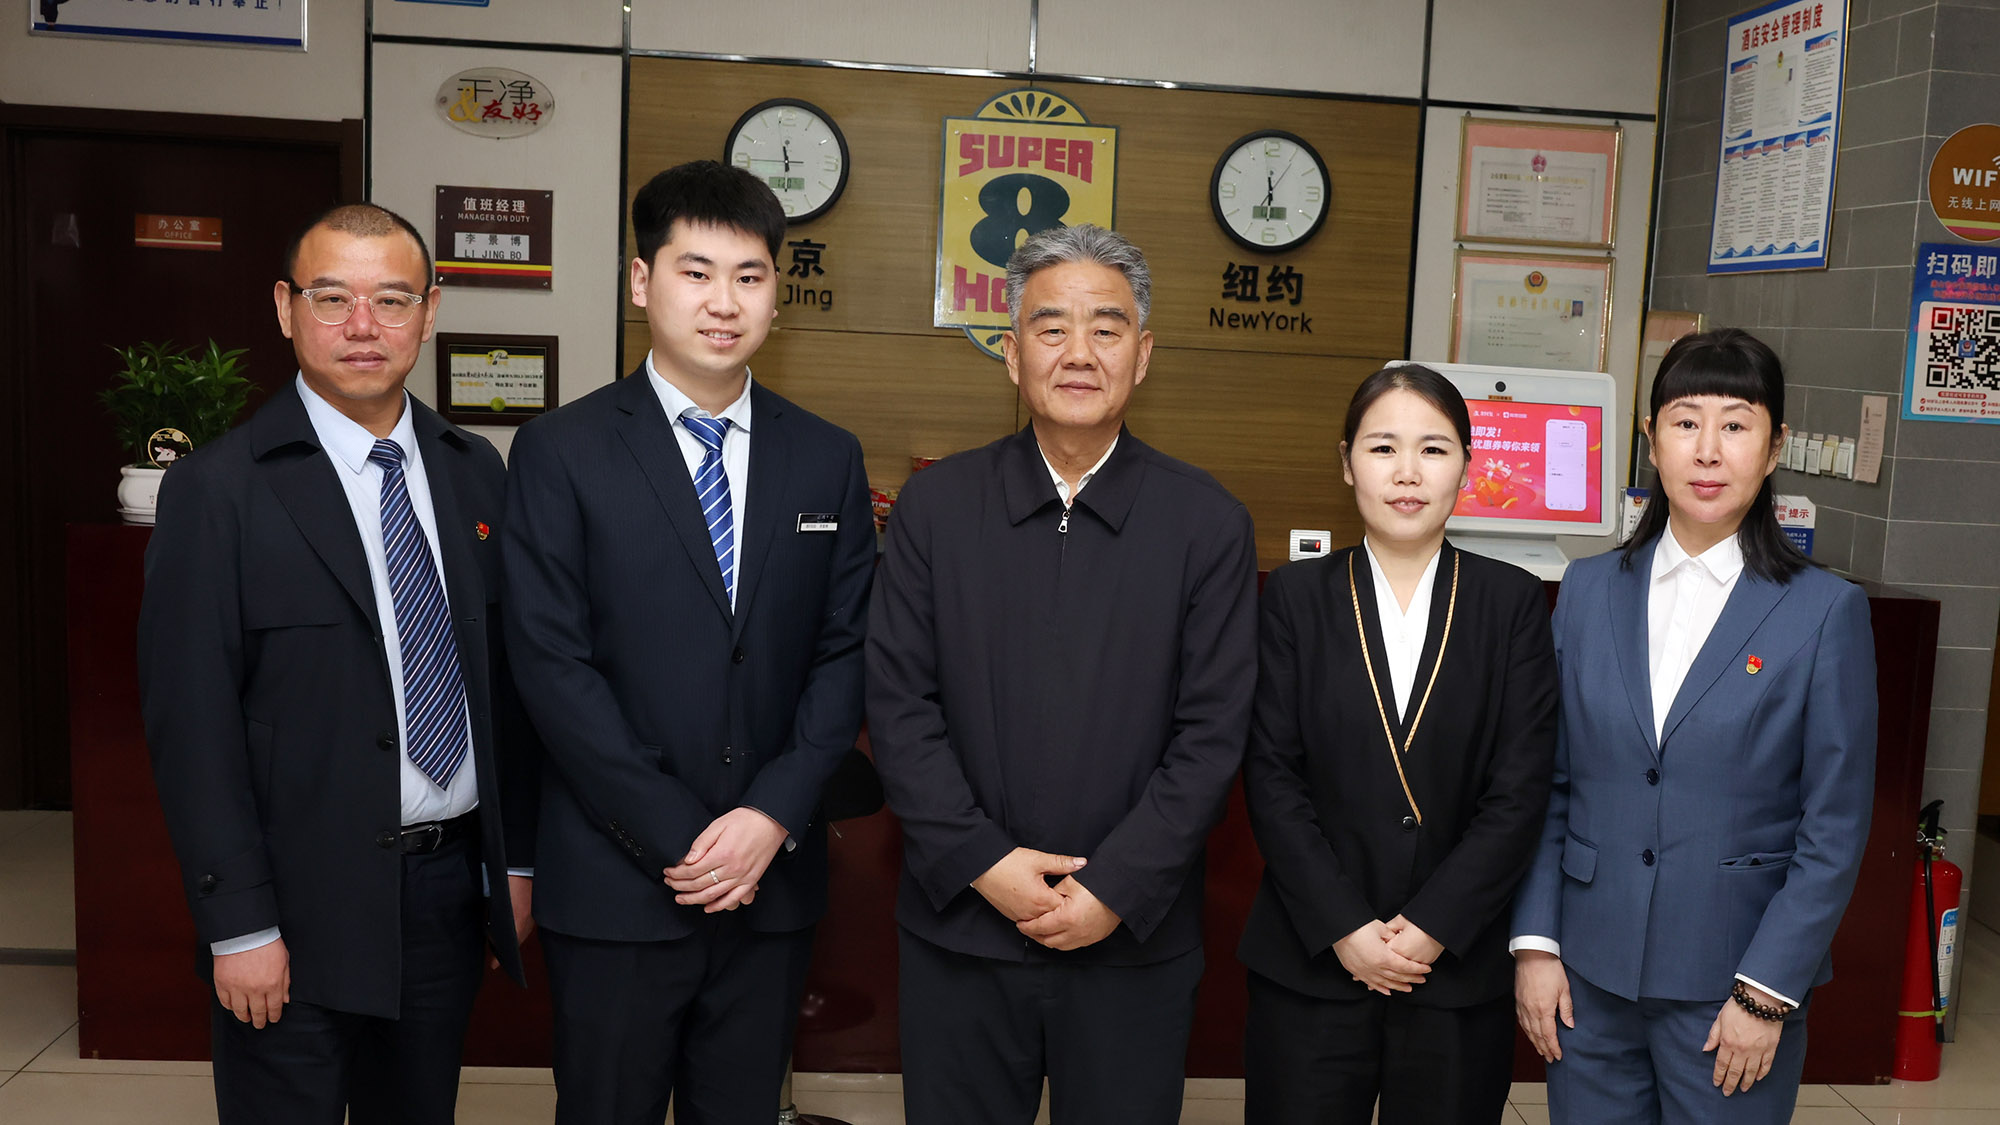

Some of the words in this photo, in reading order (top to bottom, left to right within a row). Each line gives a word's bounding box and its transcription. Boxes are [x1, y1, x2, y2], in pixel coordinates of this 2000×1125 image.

[1741, 3, 1823, 52] 酒店安全管理制度
[457, 78, 536, 105] 干净
[482, 99, 542, 121] 友好
[958, 133, 1095, 184] SUPER
[463, 196, 526, 213] 值班经理
[1947, 196, 2000, 212] 无线上网
[158, 219, 200, 231] 办公室
[458, 212, 495, 222] MANAGER
[496, 214, 508, 222] ON
[509, 214, 531, 223] DUTY
[970, 173, 1071, 269] 8
[164, 231, 193, 240] OFFICE
[464, 249, 475, 259] LI
[482, 250, 505, 260] JING
[510, 251, 522, 260] BO
[776, 239, 826, 278] 京
[1926, 251, 1998, 279] 扫码即
[953, 265, 1008, 313] HO
[1222, 262, 1303, 305] 纽约
[1209, 307, 1313, 333] NewYork
[1470, 439, 1541, 453] 优惠券等你来领
[1788, 508, 1810, 519] 提示
